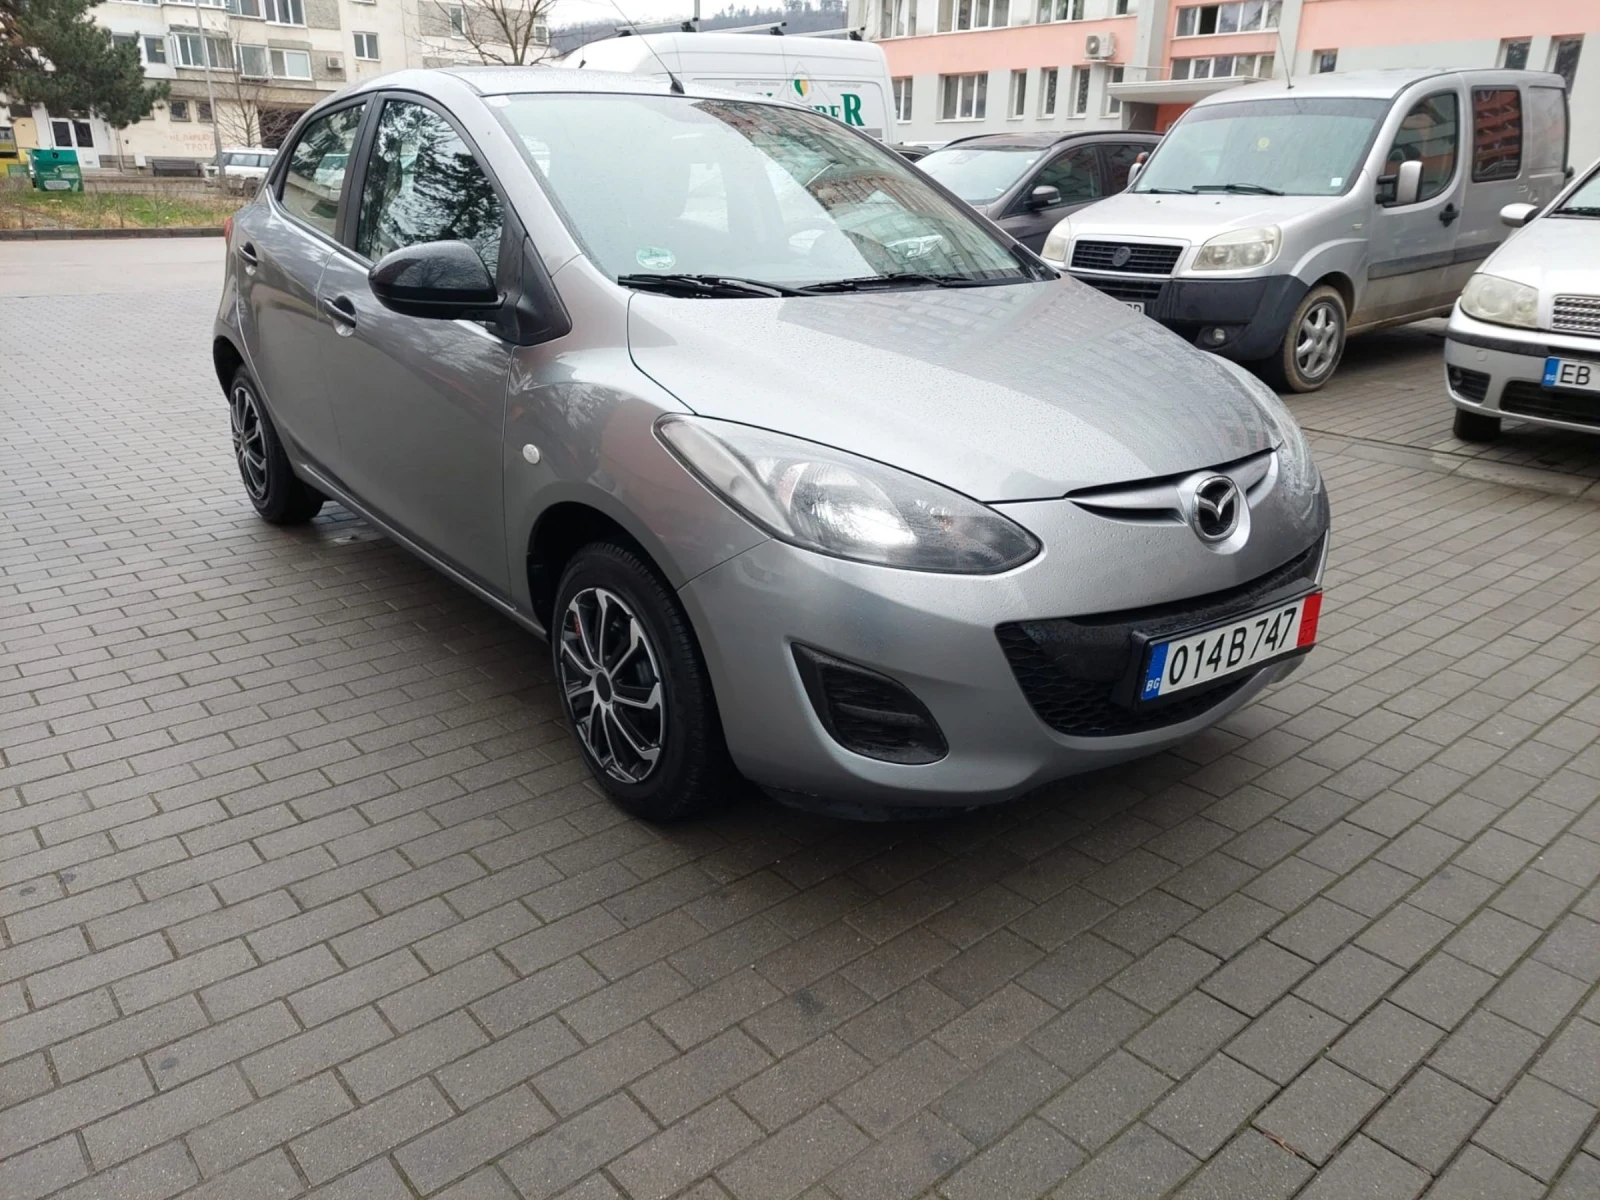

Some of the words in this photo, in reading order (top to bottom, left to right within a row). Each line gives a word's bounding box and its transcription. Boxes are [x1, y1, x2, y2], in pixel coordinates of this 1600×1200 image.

[1560, 363, 1591, 386] EB
[1169, 606, 1298, 686] 014B747
[1145, 677, 1161, 693] BG
